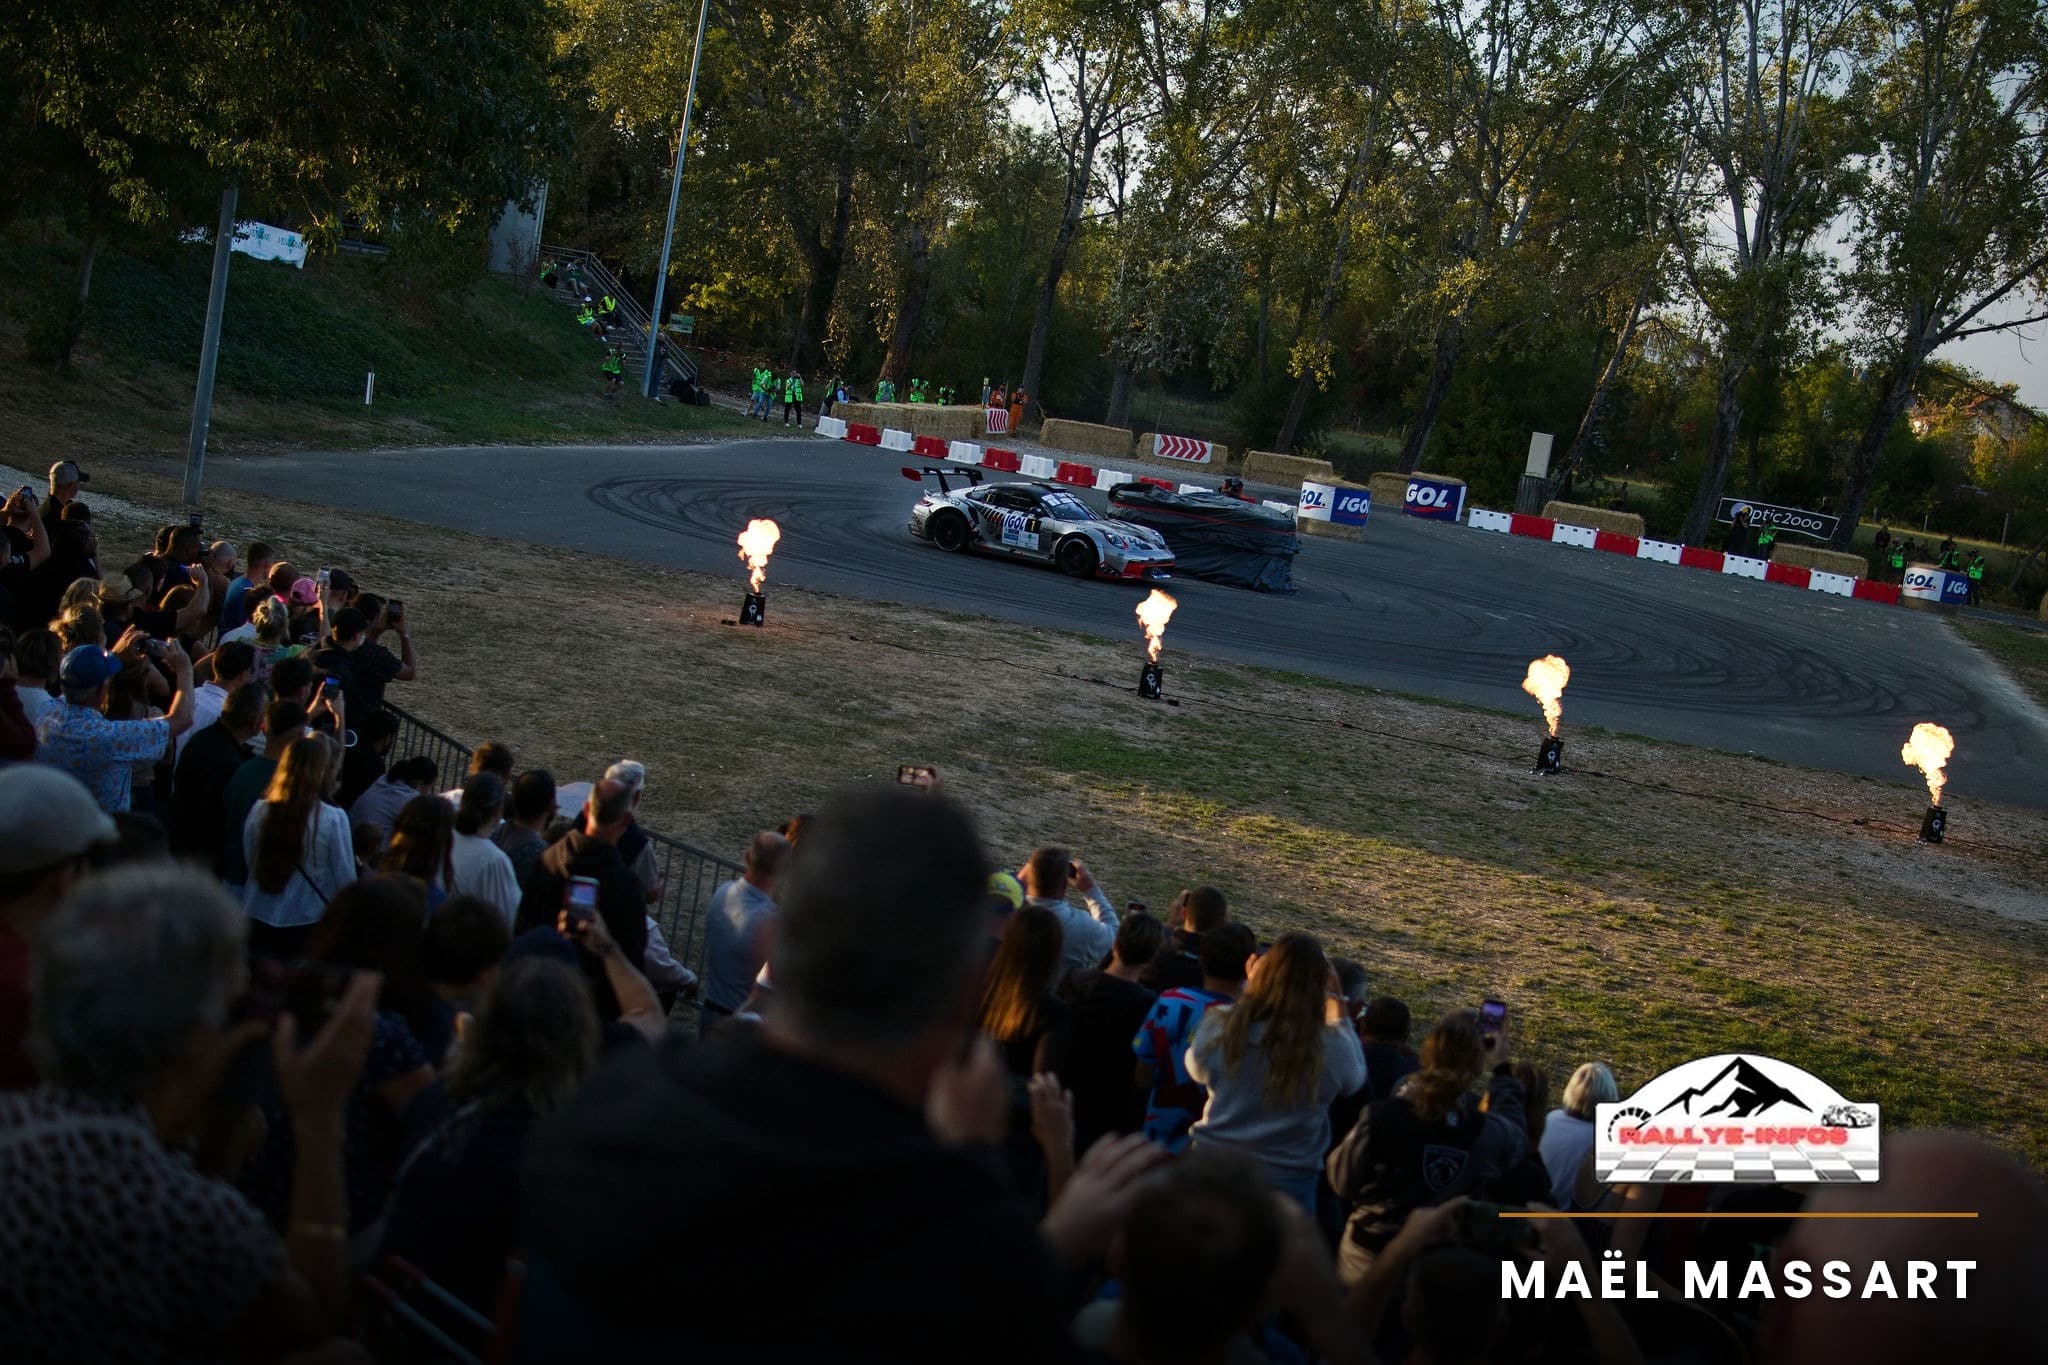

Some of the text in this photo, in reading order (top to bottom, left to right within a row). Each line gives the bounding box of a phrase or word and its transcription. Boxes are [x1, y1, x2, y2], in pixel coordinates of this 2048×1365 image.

[1337, 497, 1371, 514] IGO
[1004, 515, 1026, 531] IGOL
[1030, 520, 1036, 532] 1
